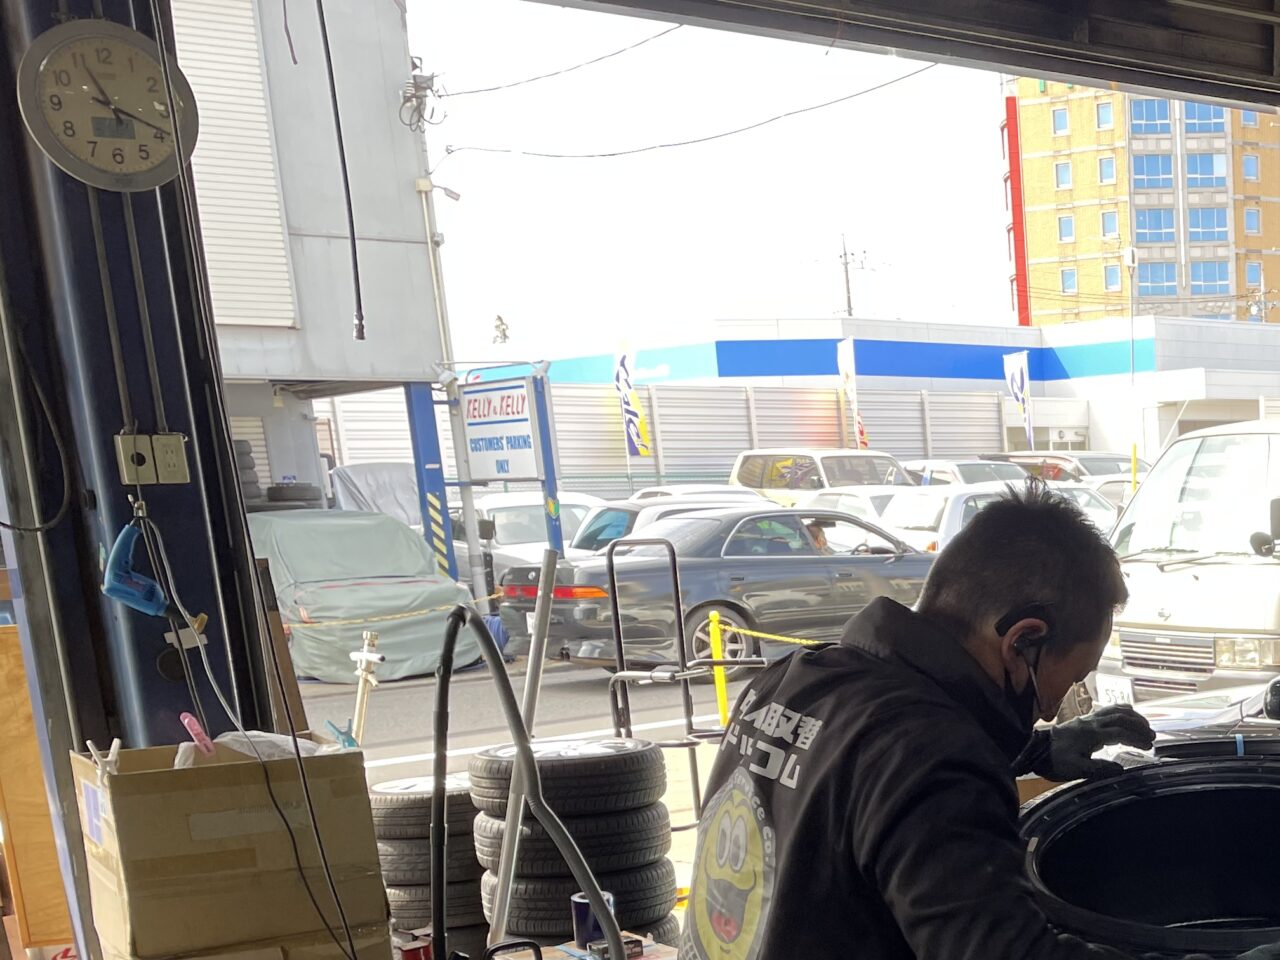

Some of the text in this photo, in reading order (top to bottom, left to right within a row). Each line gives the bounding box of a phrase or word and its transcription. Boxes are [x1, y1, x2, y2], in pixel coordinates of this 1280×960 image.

[95, 47, 113, 65] 12
[53, 69, 71, 87] 10
[146, 76, 159, 93] 2
[49, 94, 62, 111] 9
[63, 120, 75, 137] 8
[153, 127, 165, 143] 4
[86, 141, 98, 158] 7
[112, 147, 125, 165] 6
[138, 144, 150, 160] 5
[466, 398, 492, 419] KELLY
[499, 394, 526, 416] KELLY
[506, 434, 532, 450] PARKING
